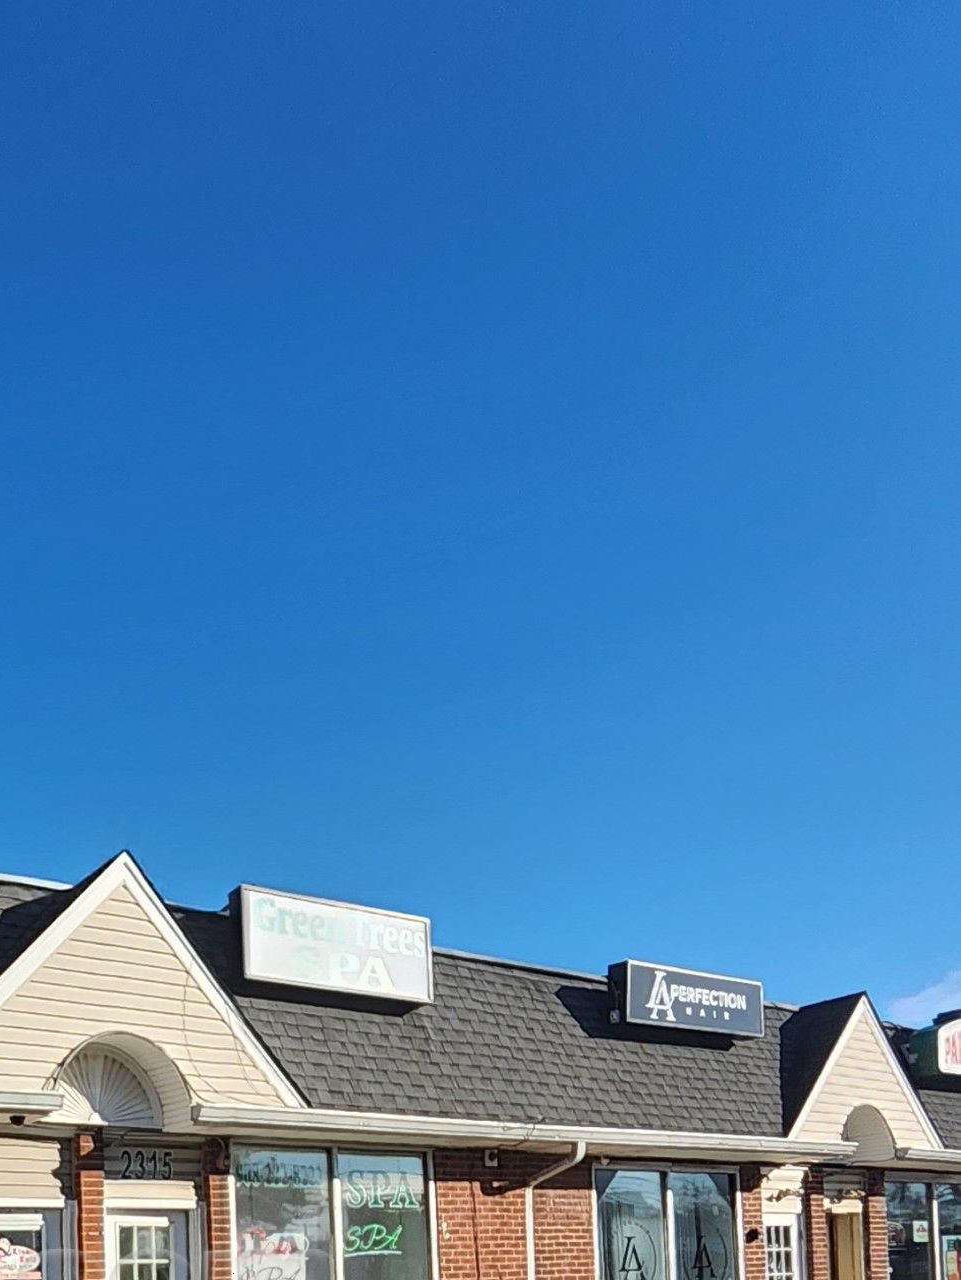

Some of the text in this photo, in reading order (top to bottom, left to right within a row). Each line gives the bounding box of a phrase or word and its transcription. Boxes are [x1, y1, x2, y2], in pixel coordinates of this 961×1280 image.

[253, 896, 426, 958] Green Trees
[291, 945, 396, 992] SPA
[670, 983, 747, 1011] PERFECTION
[685, 1006, 730, 1021] HAIR
[120, 1150, 173, 1179] 2315
[346, 1169, 420, 1209] SPA
[343, 1223, 403, 1252] SPA
